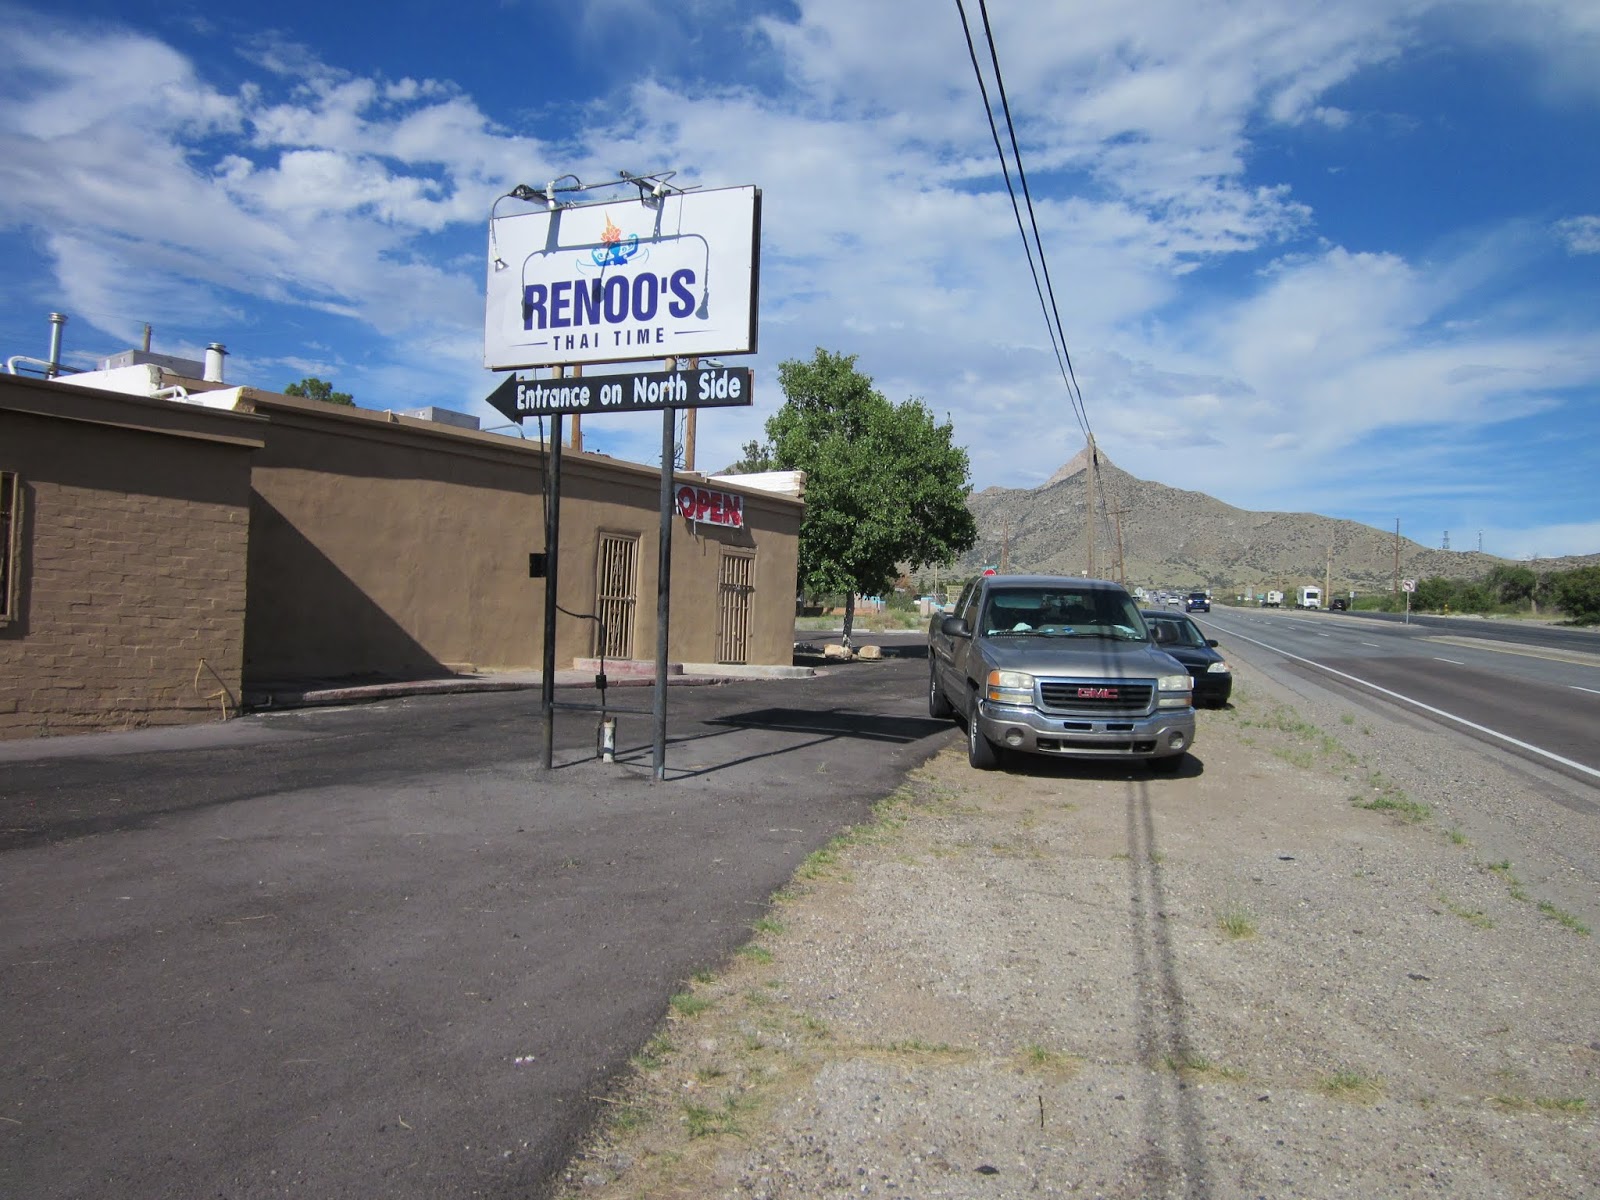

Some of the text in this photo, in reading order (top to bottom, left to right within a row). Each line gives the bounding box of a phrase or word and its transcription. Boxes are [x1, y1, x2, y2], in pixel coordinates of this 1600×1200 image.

[523, 269, 696, 330] RENOO'S
[553, 327, 664, 350] THAI TIME
[517, 370, 741, 410] Entrance on North Side
[677, 486, 742, 526] OPEN
[1078, 688, 1118, 699] GMC
